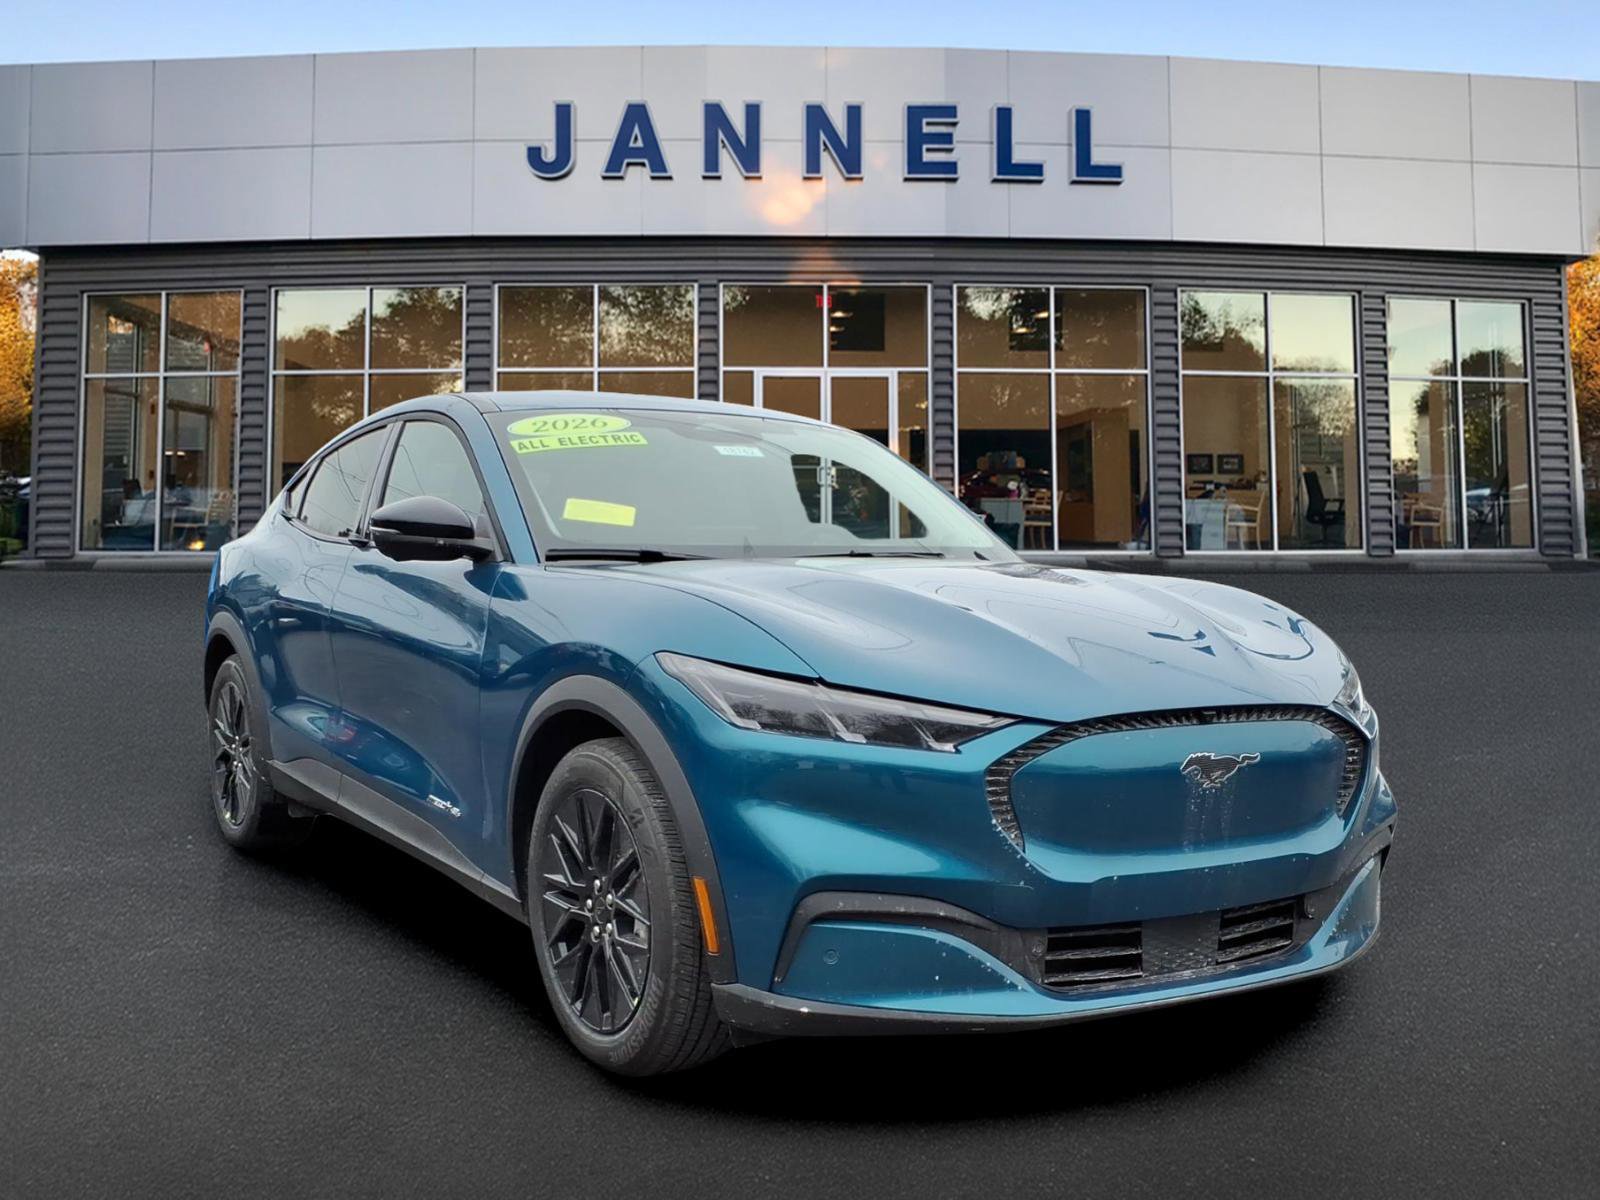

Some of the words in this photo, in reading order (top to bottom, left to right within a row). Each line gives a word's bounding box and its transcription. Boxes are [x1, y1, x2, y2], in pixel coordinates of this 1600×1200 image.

[526, 100, 1124, 184] JANNELL
[531, 417, 609, 433] 2026
[517, 439, 550, 452] ALL
[557, 433, 642, 447] ELECTRIC
